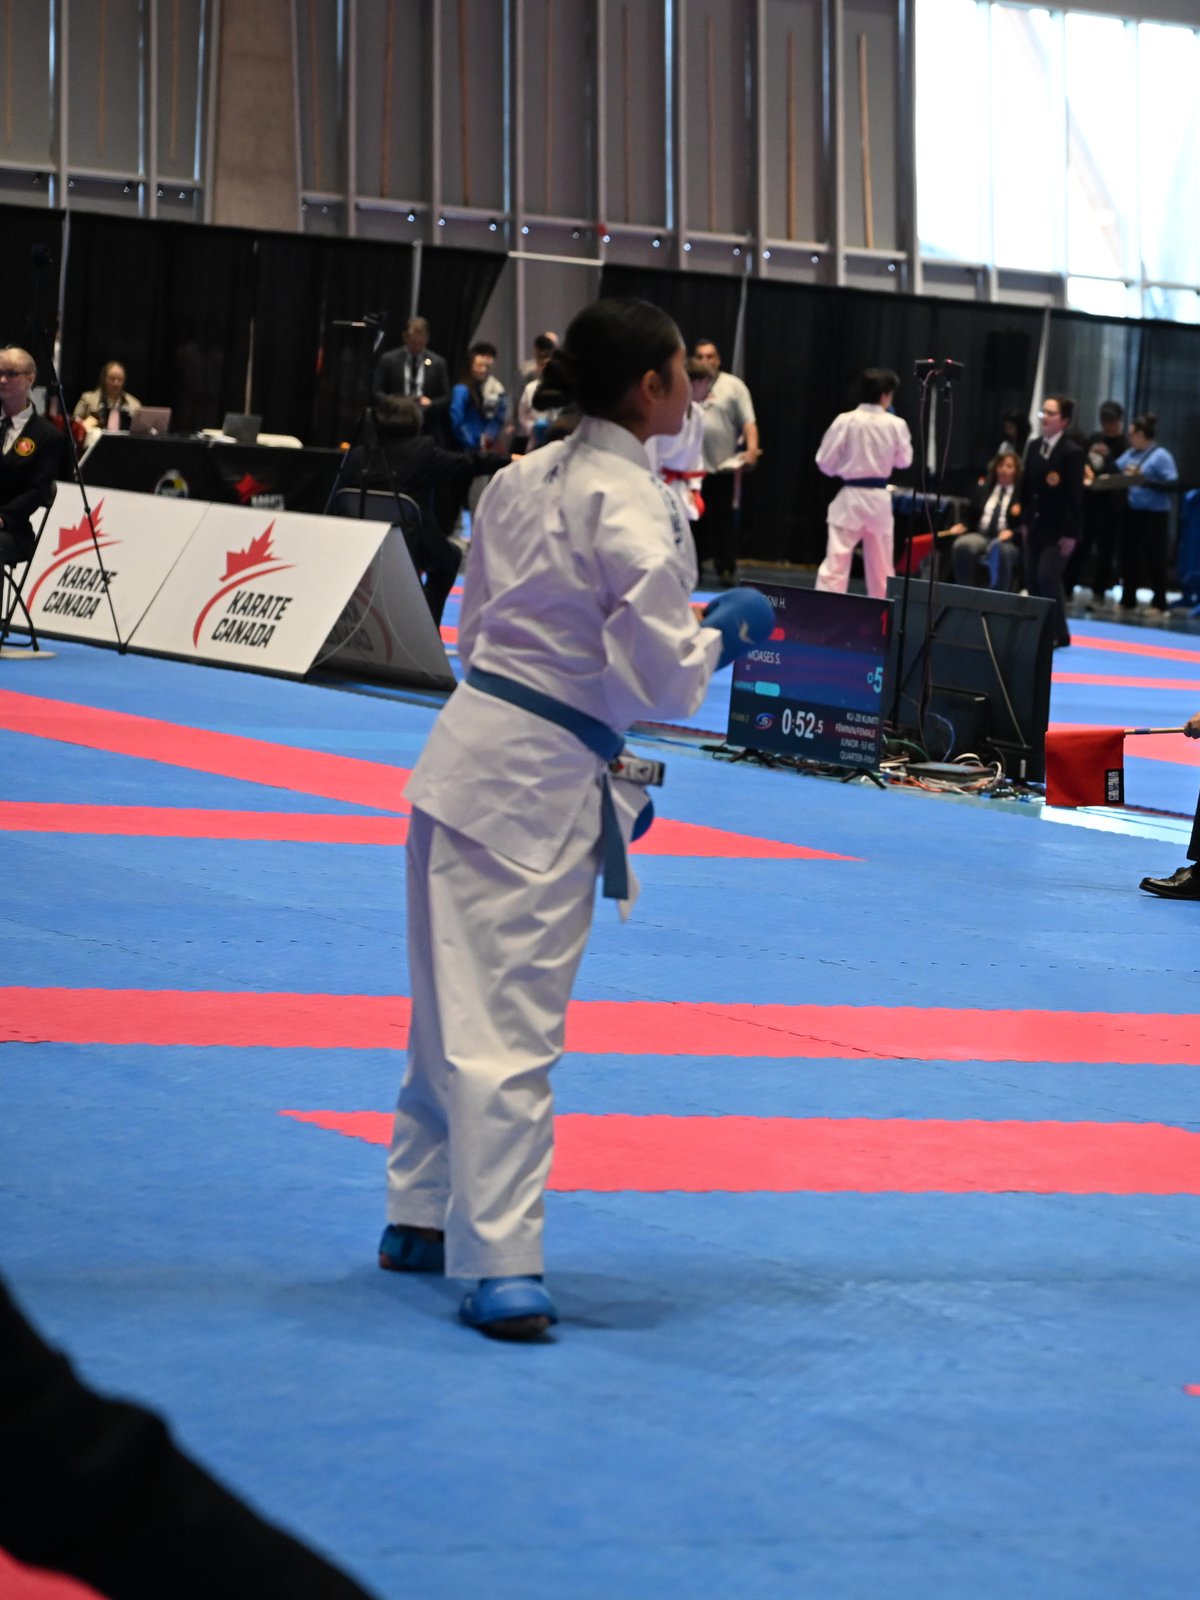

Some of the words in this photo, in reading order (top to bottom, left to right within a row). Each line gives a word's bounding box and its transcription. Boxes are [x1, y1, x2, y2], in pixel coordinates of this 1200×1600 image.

[57, 564, 117, 593] KARATE
[42, 591, 101, 619] CANADA
[226, 590, 293, 620] KARATE
[211, 618, 276, 648] CANADA
